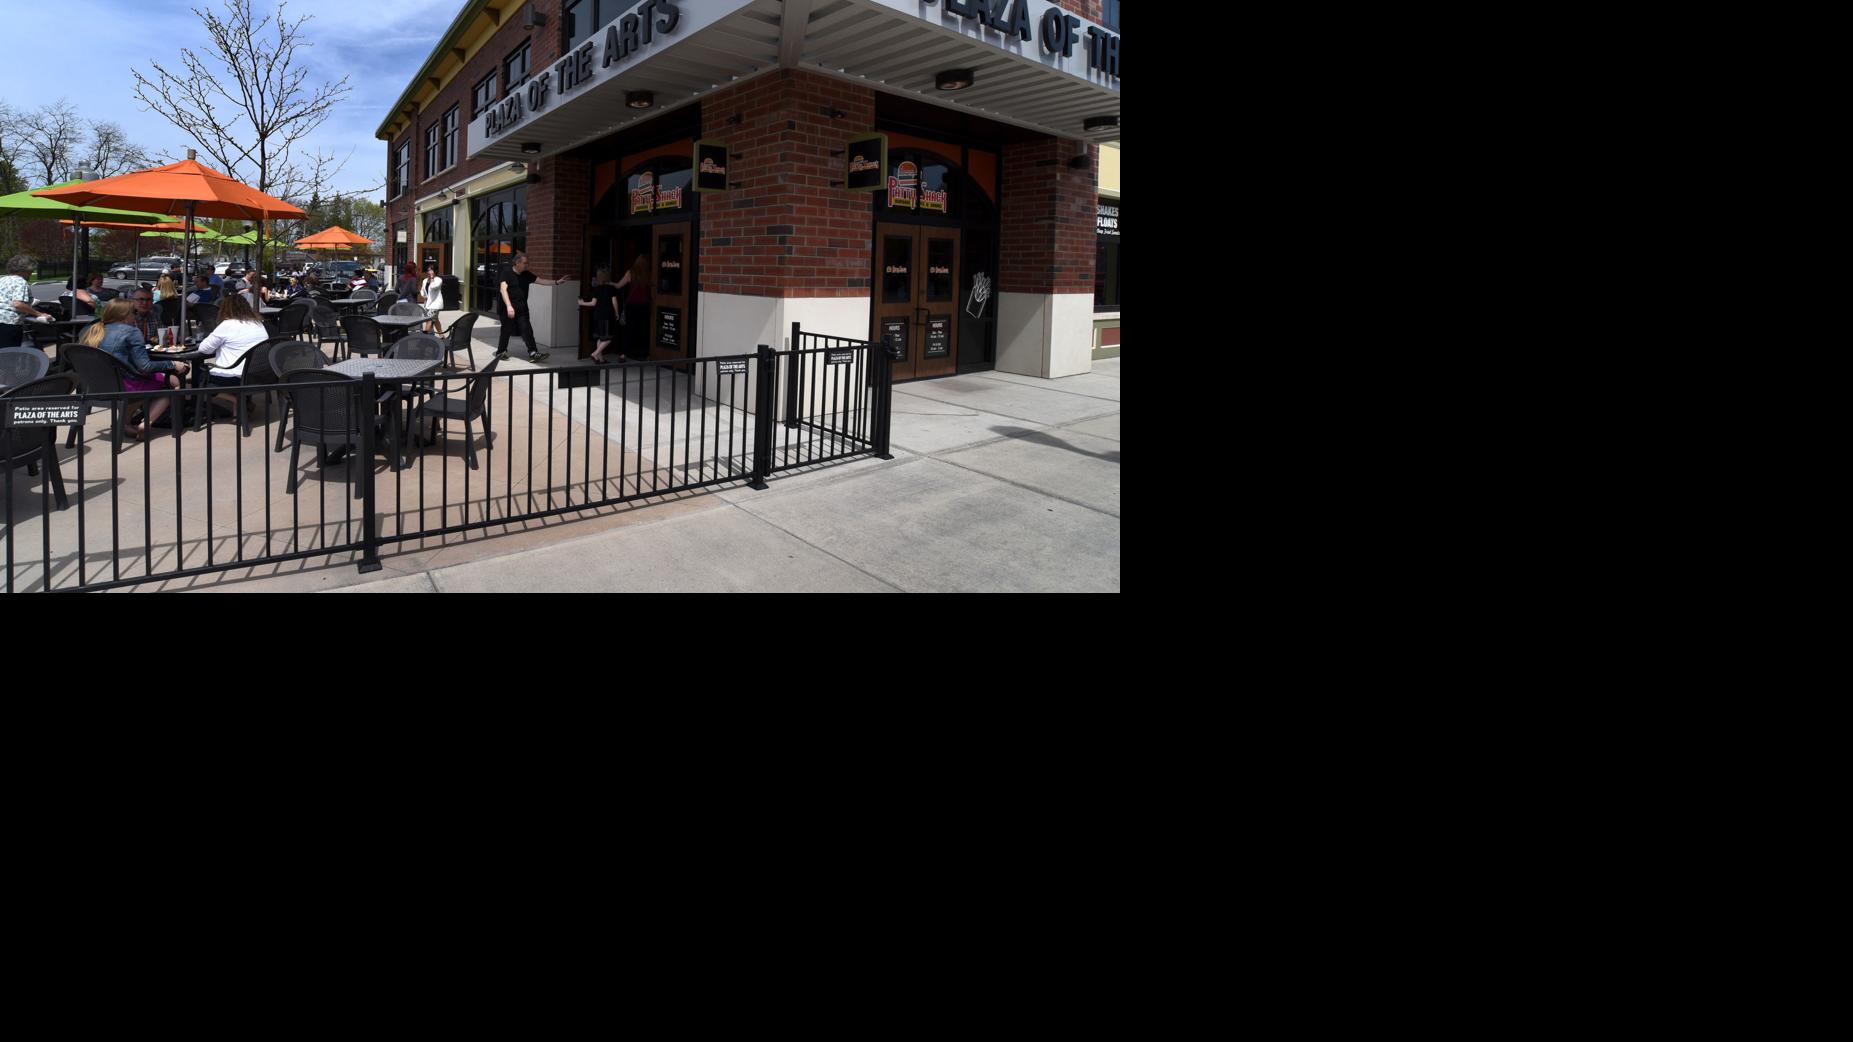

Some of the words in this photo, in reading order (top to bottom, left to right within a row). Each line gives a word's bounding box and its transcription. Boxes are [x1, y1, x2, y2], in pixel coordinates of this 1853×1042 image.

[920, 0, 1032, 42] AZA
[1043, 7, 1080, 57] OF
[485, 92, 522, 138] PLAZA
[527, 72, 549, 112] OF
[555, 41, 594, 95] THE
[602, 0, 680, 68] ARTS
[1097, 216, 1118, 229] FLOATS
[14, 411, 36, 419] PLAZA
[37, 411, 46, 419] OF
